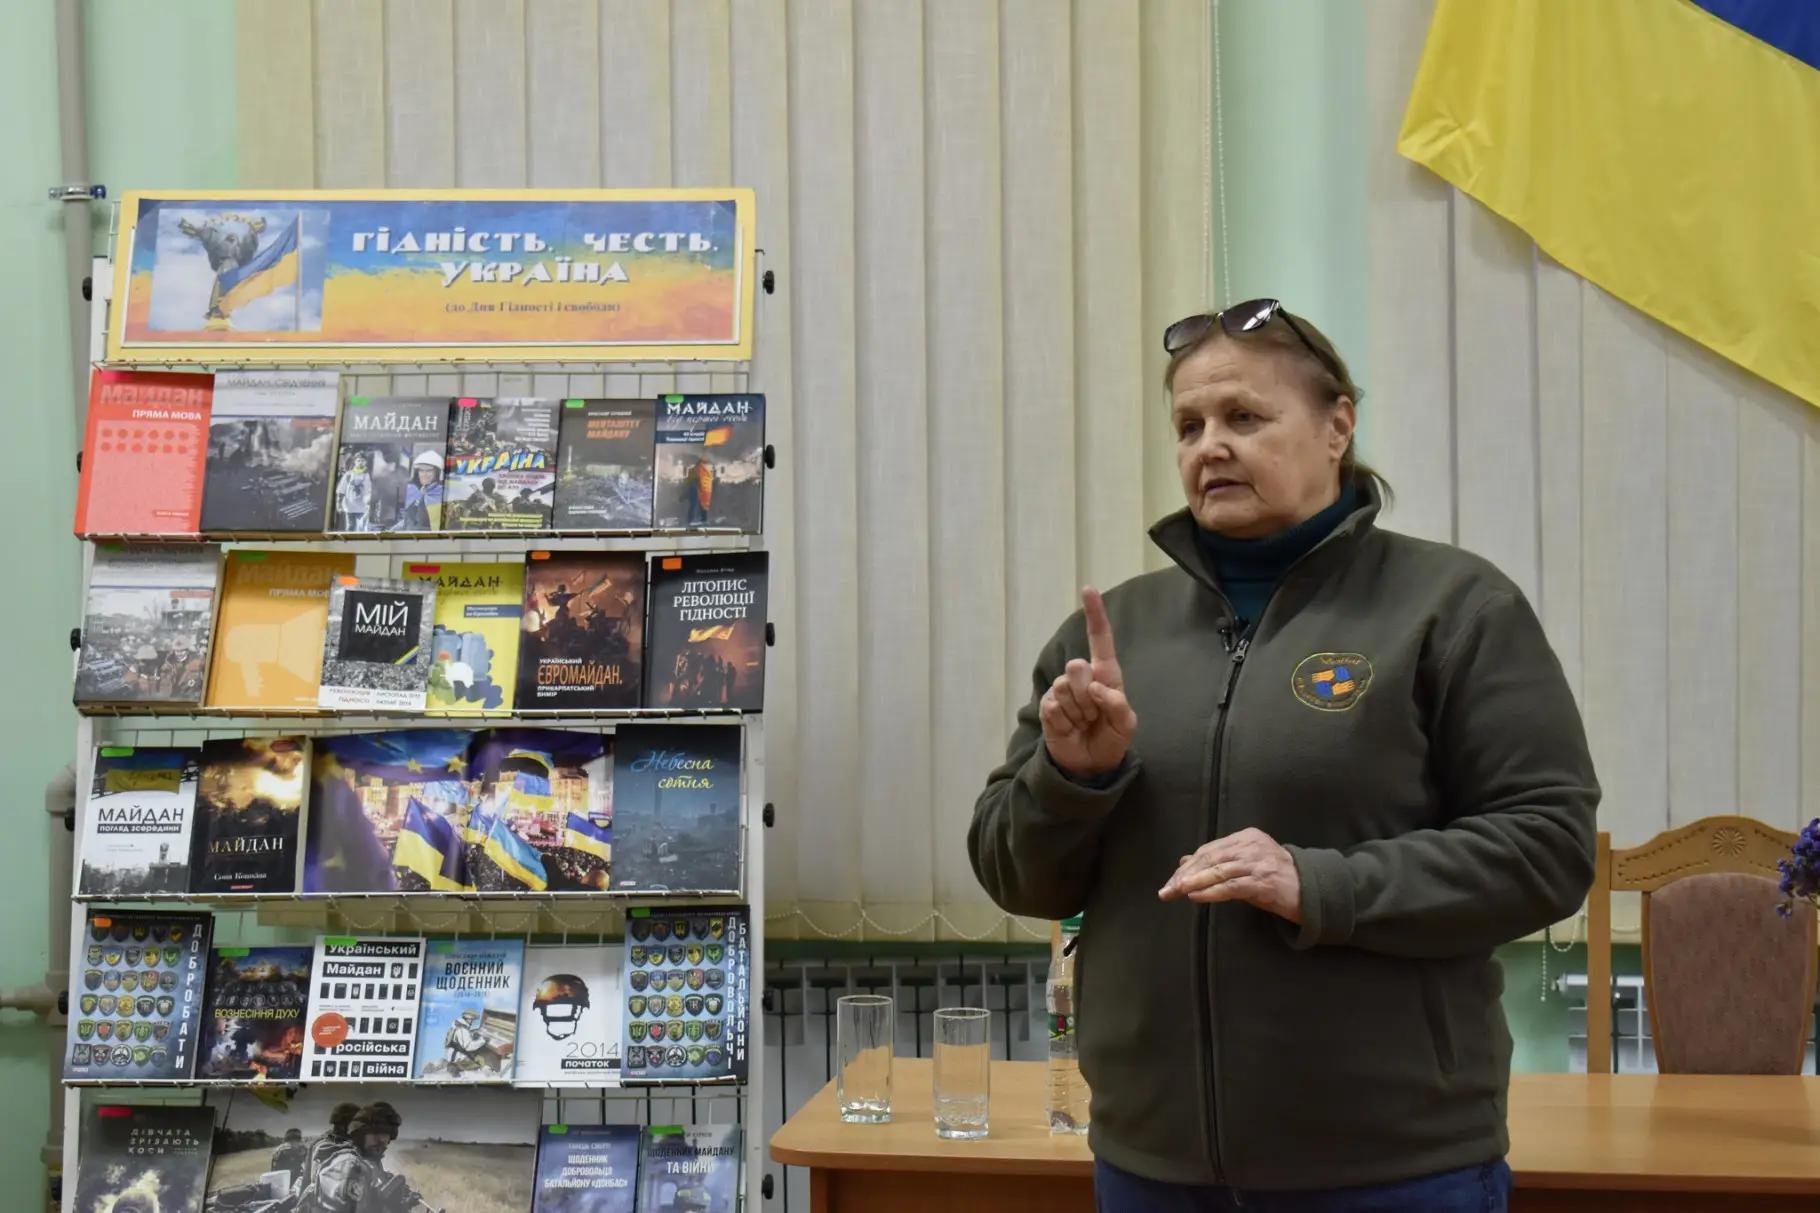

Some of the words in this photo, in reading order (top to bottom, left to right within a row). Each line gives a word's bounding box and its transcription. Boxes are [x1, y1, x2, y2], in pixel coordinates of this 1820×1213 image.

[352, 227, 553, 253] ГІДНІСТЬ.
[583, 231, 719, 253] ЧЕСТЬ.
[439, 257, 631, 287] УКРАЇНА
[132, 408, 169, 419] ПРЯМА
[171, 410, 202, 420] МОВА
[666, 401, 752, 415] МАЙДАН
[353, 411, 438, 432] МАЙДАН
[456, 448, 545, 474] УКРАЇНА
[681, 578, 748, 594] ЛІТОПИС
[673, 590, 756, 608] РЕВОЛЮЦІЇ
[355, 600, 409, 627] МІЙ
[679, 606, 747, 623] ГІДНОСТІ
[355, 624, 406, 637] МАЙДАН
[539, 657, 582, 665] УКРАЇНСЬКИЙ
[537, 660, 623, 690] ЄВРОМАЙДАН.
[630, 750, 715, 772] Небесна
[657, 774, 714, 790] сотня
[98, 805, 184, 824] МАЙДАН
[208, 836, 284, 853] МАЙДАН
[329, 943, 417, 956] Український
[326, 963, 382, 976] Майдан
[445, 959, 504, 975] ВОЄННИЙ
[436, 975, 511, 992] ЩОДЕННИК
[737, 922, 747, 1061] БАТАЛЬЙОНИ
[175, 923, 203, 1069] ДОБРОБАТИ
[726, 916, 737, 1070] ДОБРОВОЛЬЧІ
[214, 1008, 274, 1019] ВОЗНЕСІННЯ
[275, 1008, 301, 1019] ДУХУ
[335, 1041, 407, 1054] російська
[566, 1041, 619, 1058] 2014
[366, 1063, 405, 1075] війна
[565, 1060, 610, 1068] початок
[130, 1128, 191, 1136] ДІВЧАТА
[129, 1137, 200, 1146] ЗРІЗАЮТЬ
[567, 1154, 608, 1164] ЩОДЕННИК
[694, 1145, 735, 1157] МАЙДАНУ
[561, 1166, 613, 1176] ДОБРОВОЛЬЦЯ
[666, 1161, 681, 1174] ТА
[681, 1160, 715, 1174] ВІЙНИ
[543, 1178, 590, 1188] БАТАЛЬЙОНУ
